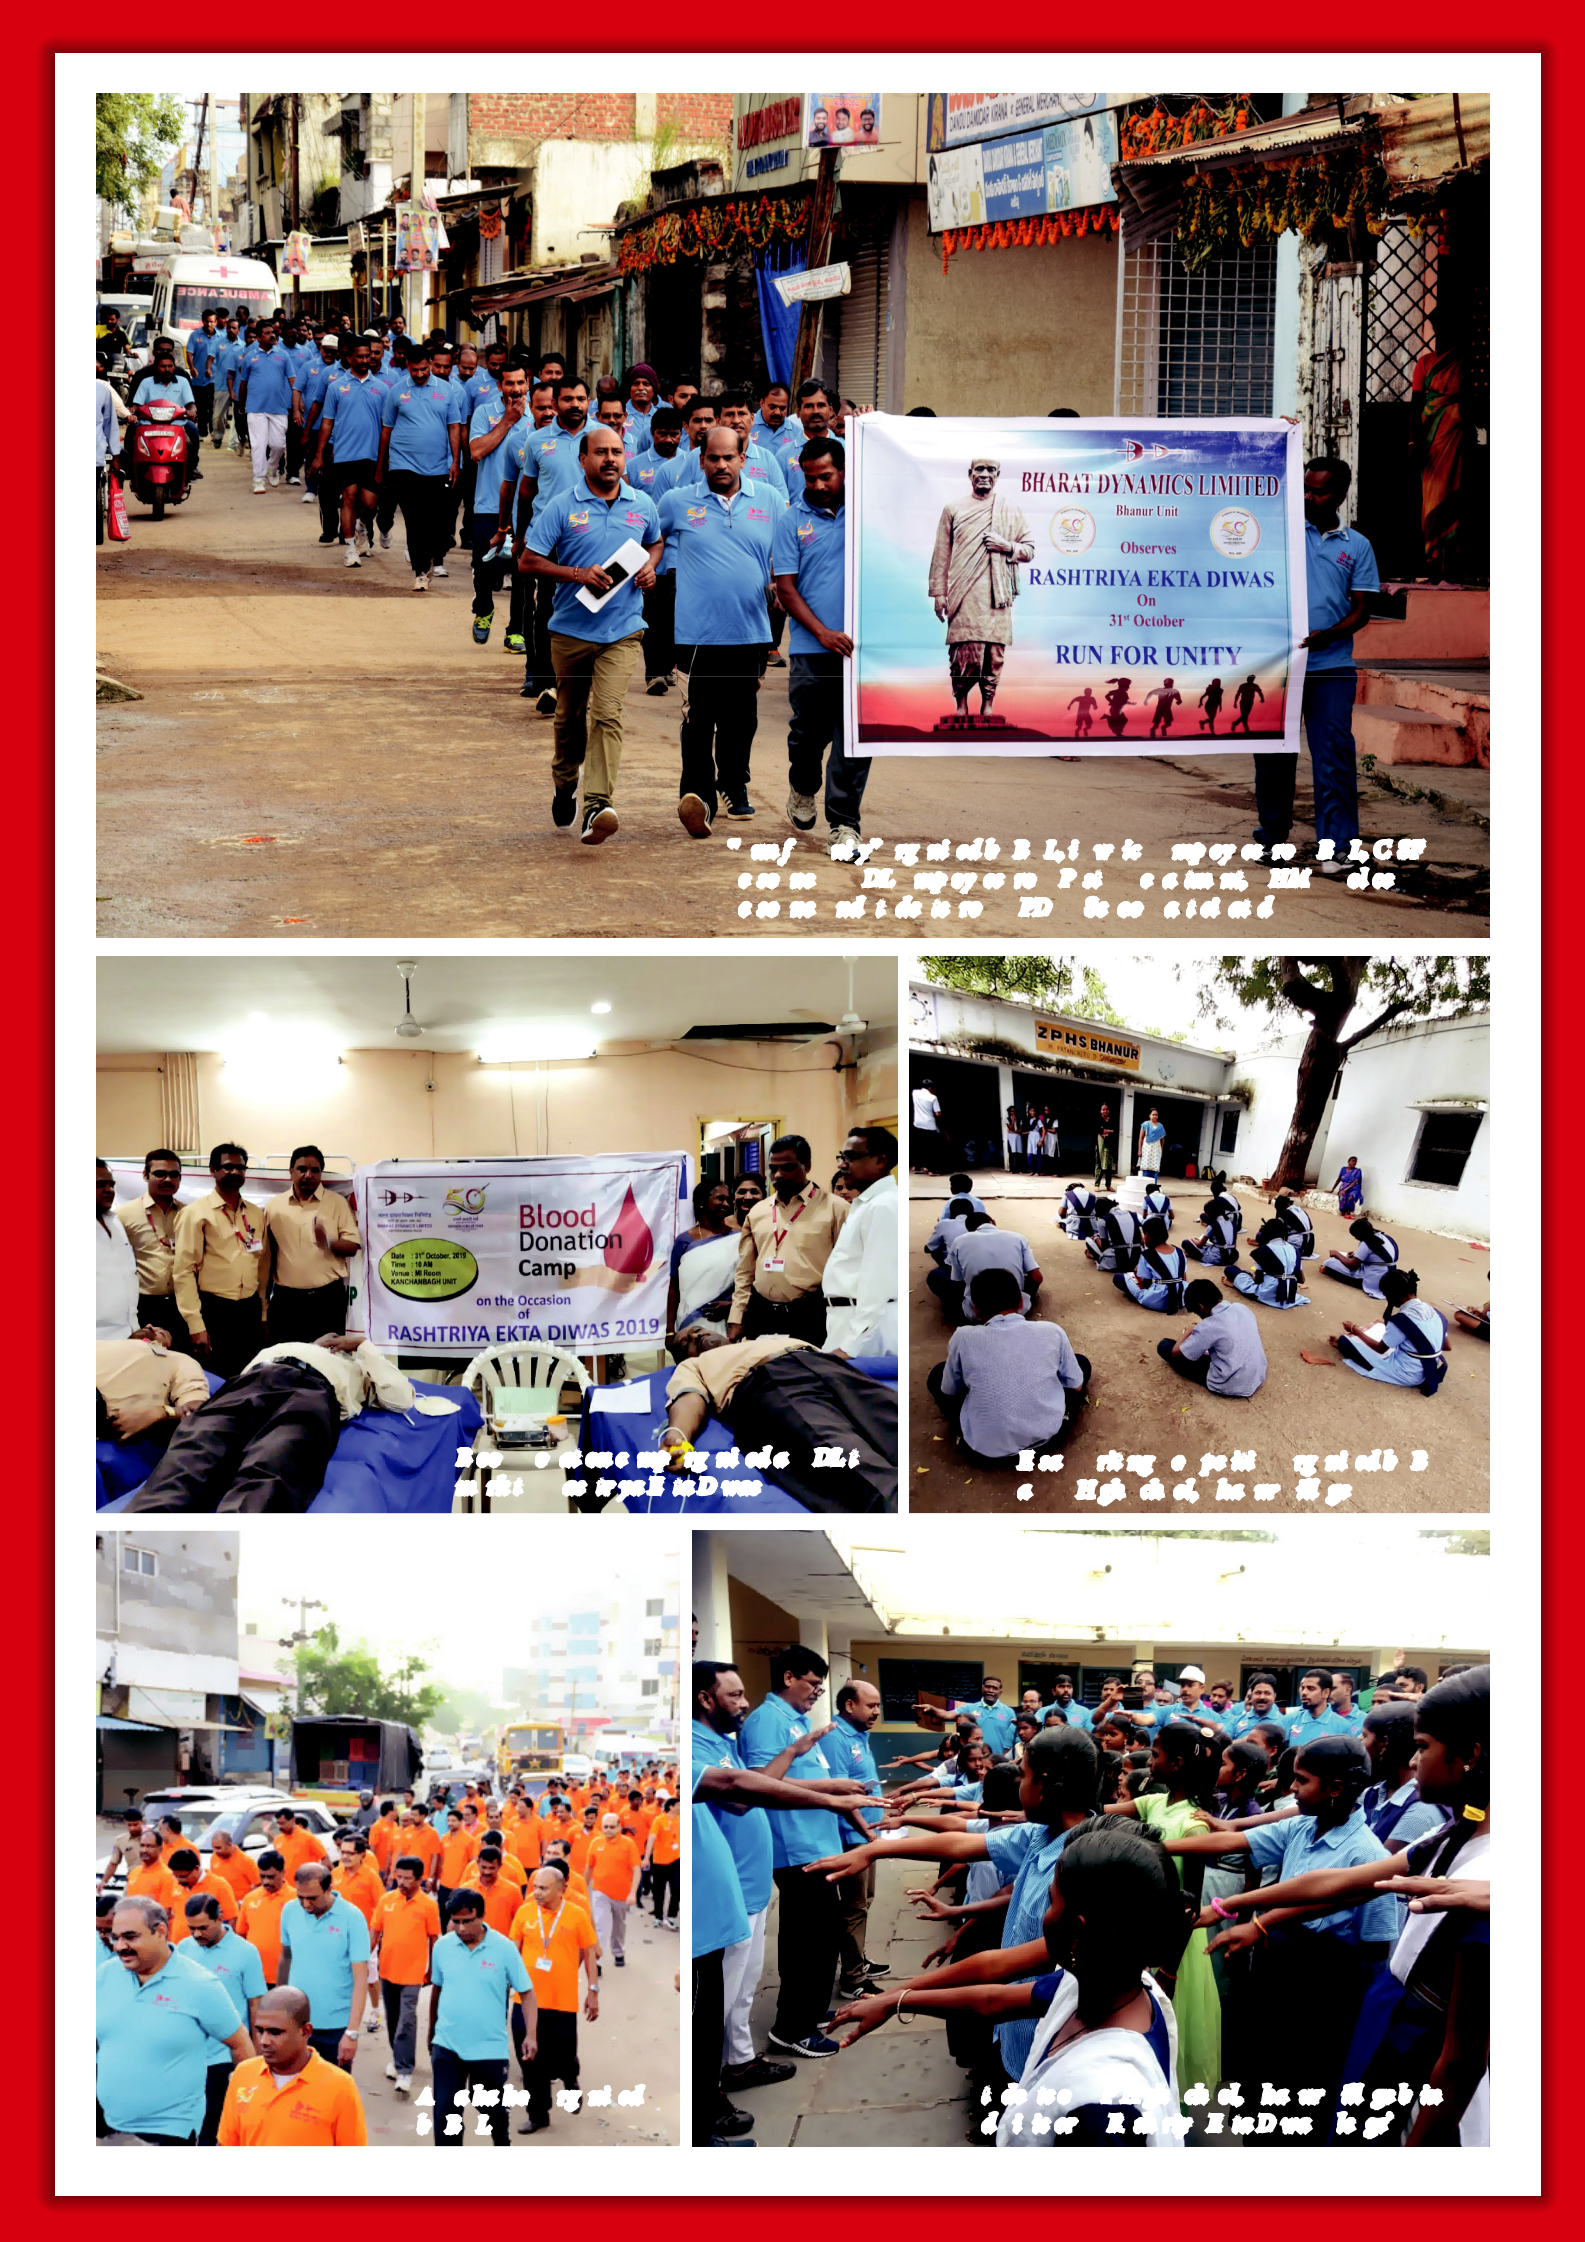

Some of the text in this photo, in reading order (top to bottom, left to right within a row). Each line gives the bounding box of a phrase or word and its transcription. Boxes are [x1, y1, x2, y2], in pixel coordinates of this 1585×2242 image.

[991, 102, 1008, 122] KIRANA
[1015, 96, 1035, 117] GENERAL
[1021, 471, 1280, 497] BHARAT DYNAMICS LIMITED
[1115, 504, 1179, 517] Bhanur Unit
[1120, 541, 1177, 555] Observes
[1028, 568, 1275, 588] RASHTRIYA EKTA DIWAS
[1136, 593, 1156, 607] On
[1109, 614, 1185, 628] 31st October
[1055, 645, 1243, 666] RUN FOR UNITY
[1090, 1038, 1139, 1060] BHANUR
[519, 1203, 596, 1229] Blood
[519, 1230, 623, 1252] Donation
[518, 1259, 577, 1280] Camp
[476, 1295, 571, 1307] on the Occasion
[517, 1308, 531, 1320] of
[388, 1318, 660, 1343] RASHTRIYA EKTA DIWAS 2019
